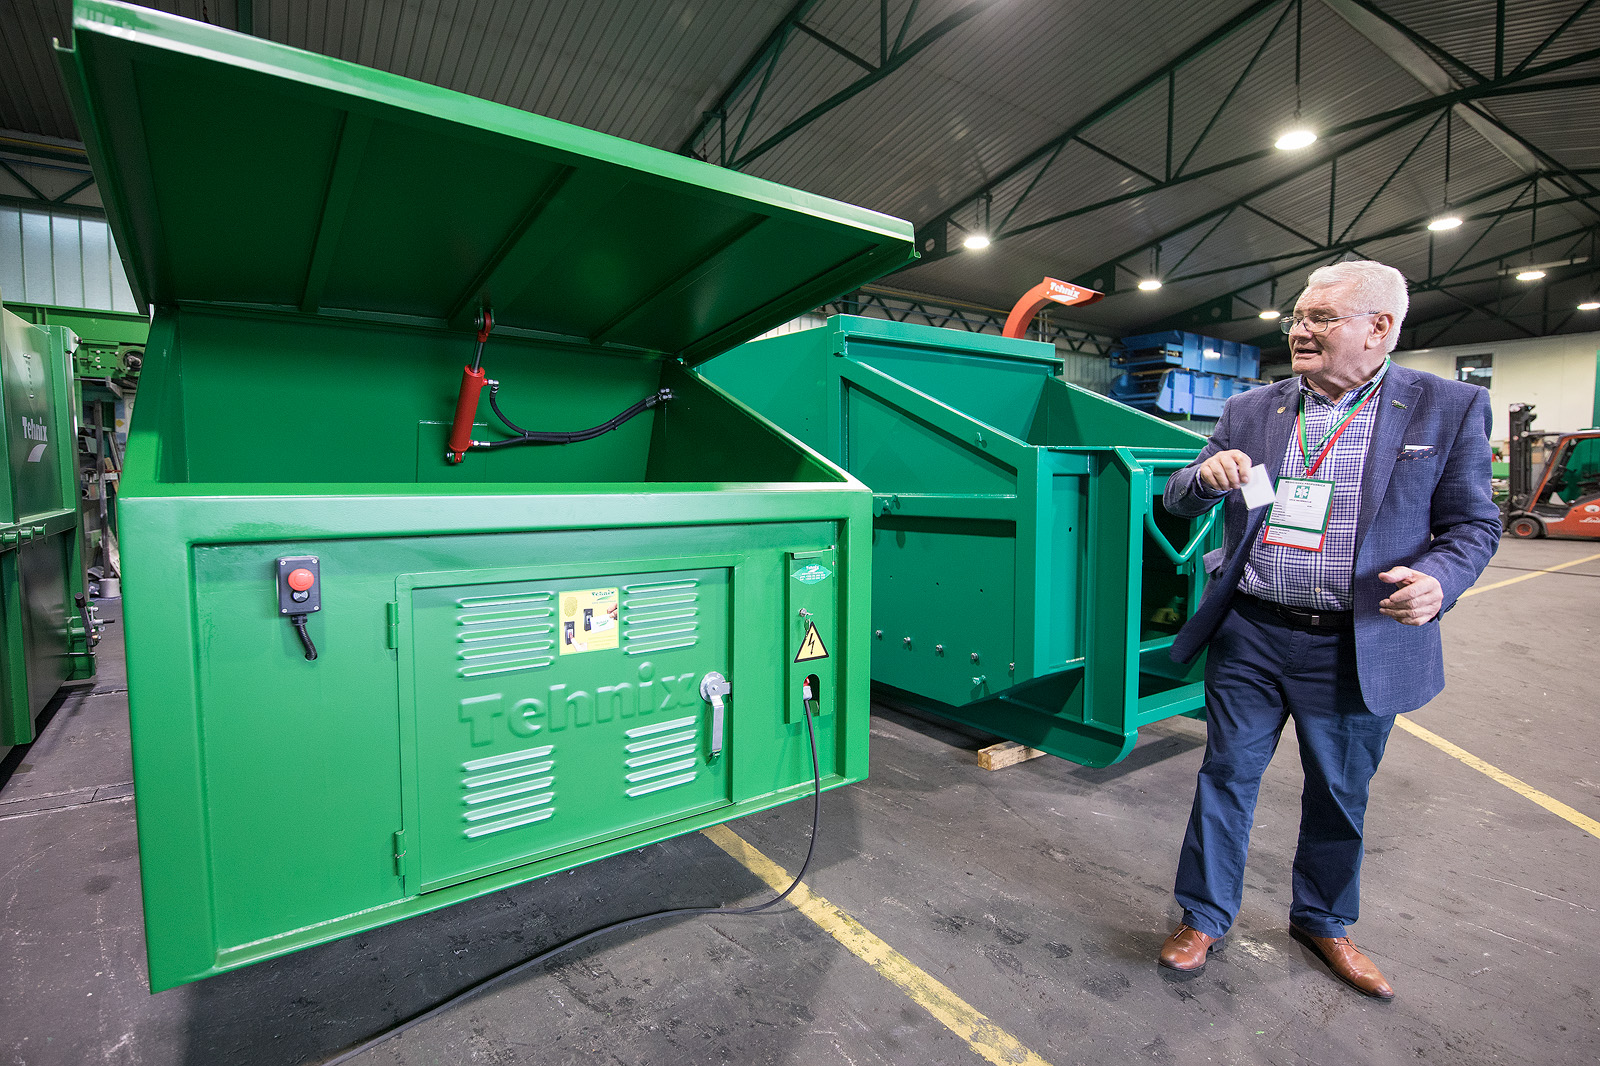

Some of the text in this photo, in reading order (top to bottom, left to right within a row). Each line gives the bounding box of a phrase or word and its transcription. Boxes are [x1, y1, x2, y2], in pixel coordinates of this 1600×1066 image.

[1050, 281, 1080, 299] Tehnix
[22, 416, 48, 442] Tehnix
[458, 661, 696, 747] Tehnix
